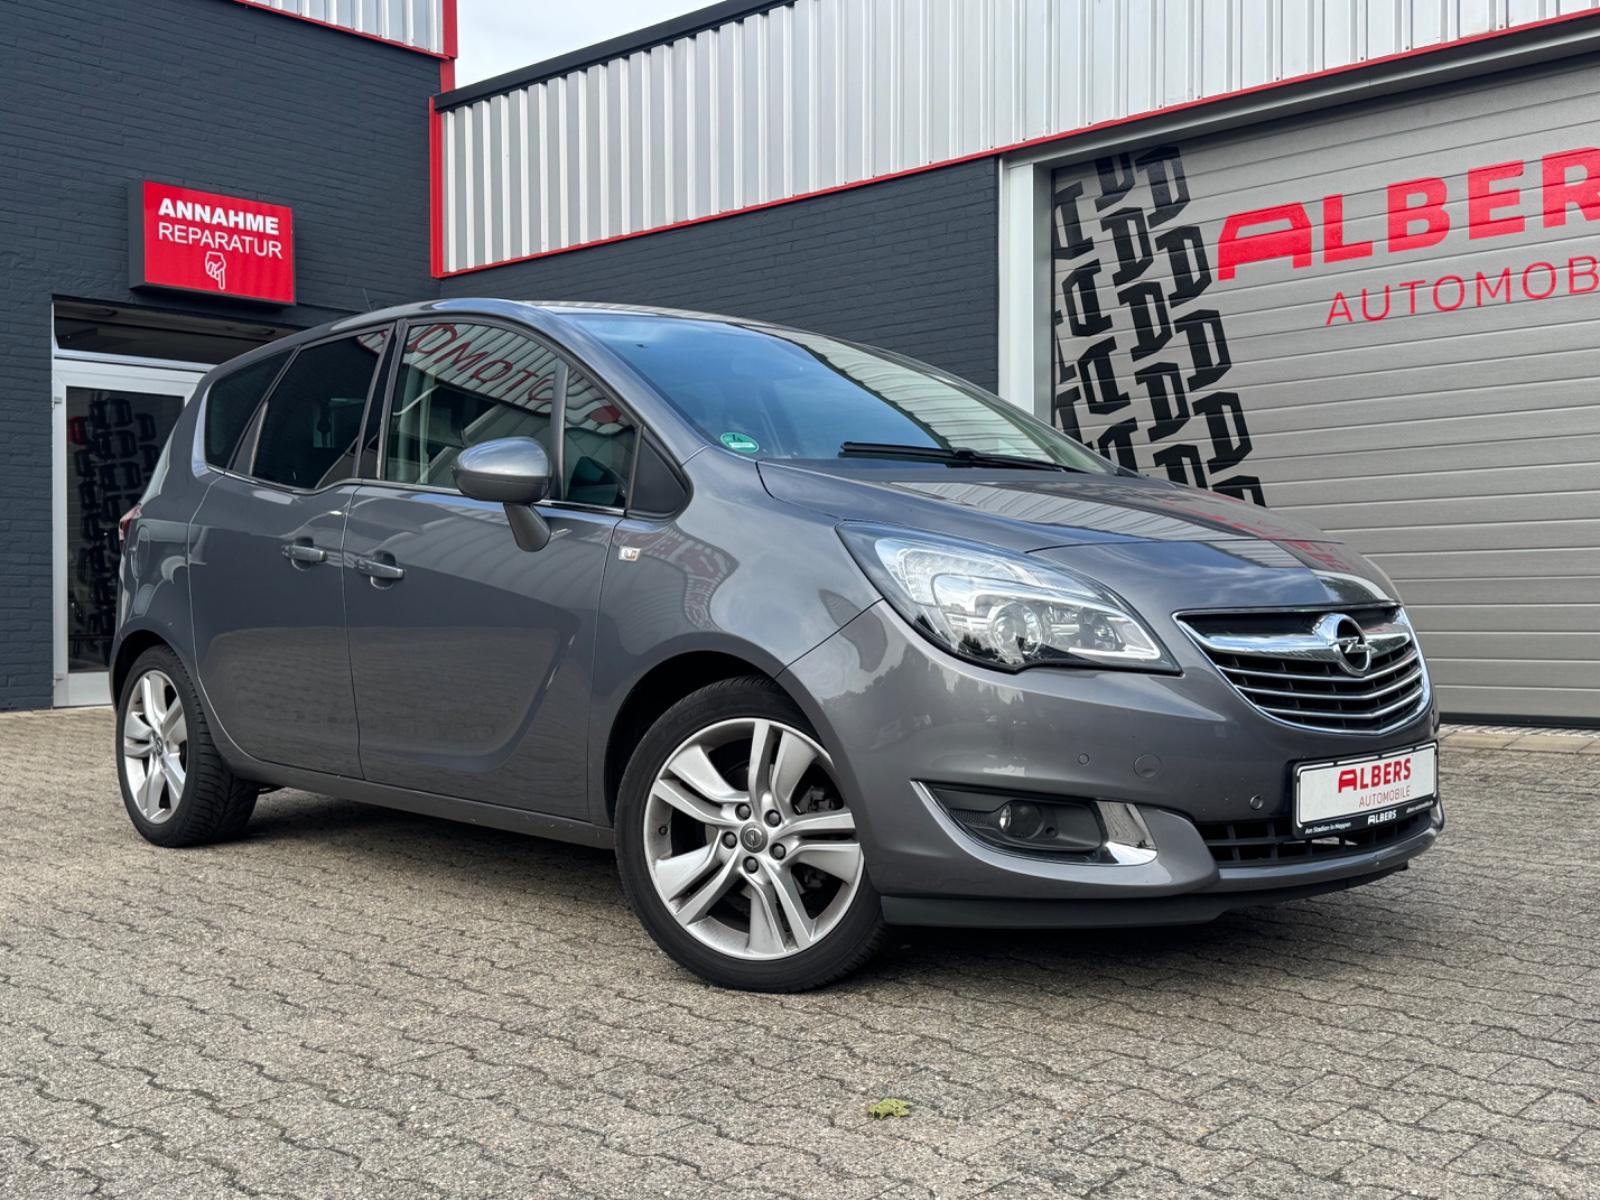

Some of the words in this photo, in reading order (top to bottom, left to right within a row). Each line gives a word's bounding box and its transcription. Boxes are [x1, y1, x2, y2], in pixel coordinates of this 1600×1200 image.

[158, 198, 279, 235] ANNAHME
[158, 222, 282, 259] REPARATUR
[1325, 255, 1600, 326] AUTOMOB
[1337, 757, 1412, 793] ALBERS
[1358, 785, 1411, 808] AUTOMOBILE
[1367, 809, 1397, 826] ALBERS
